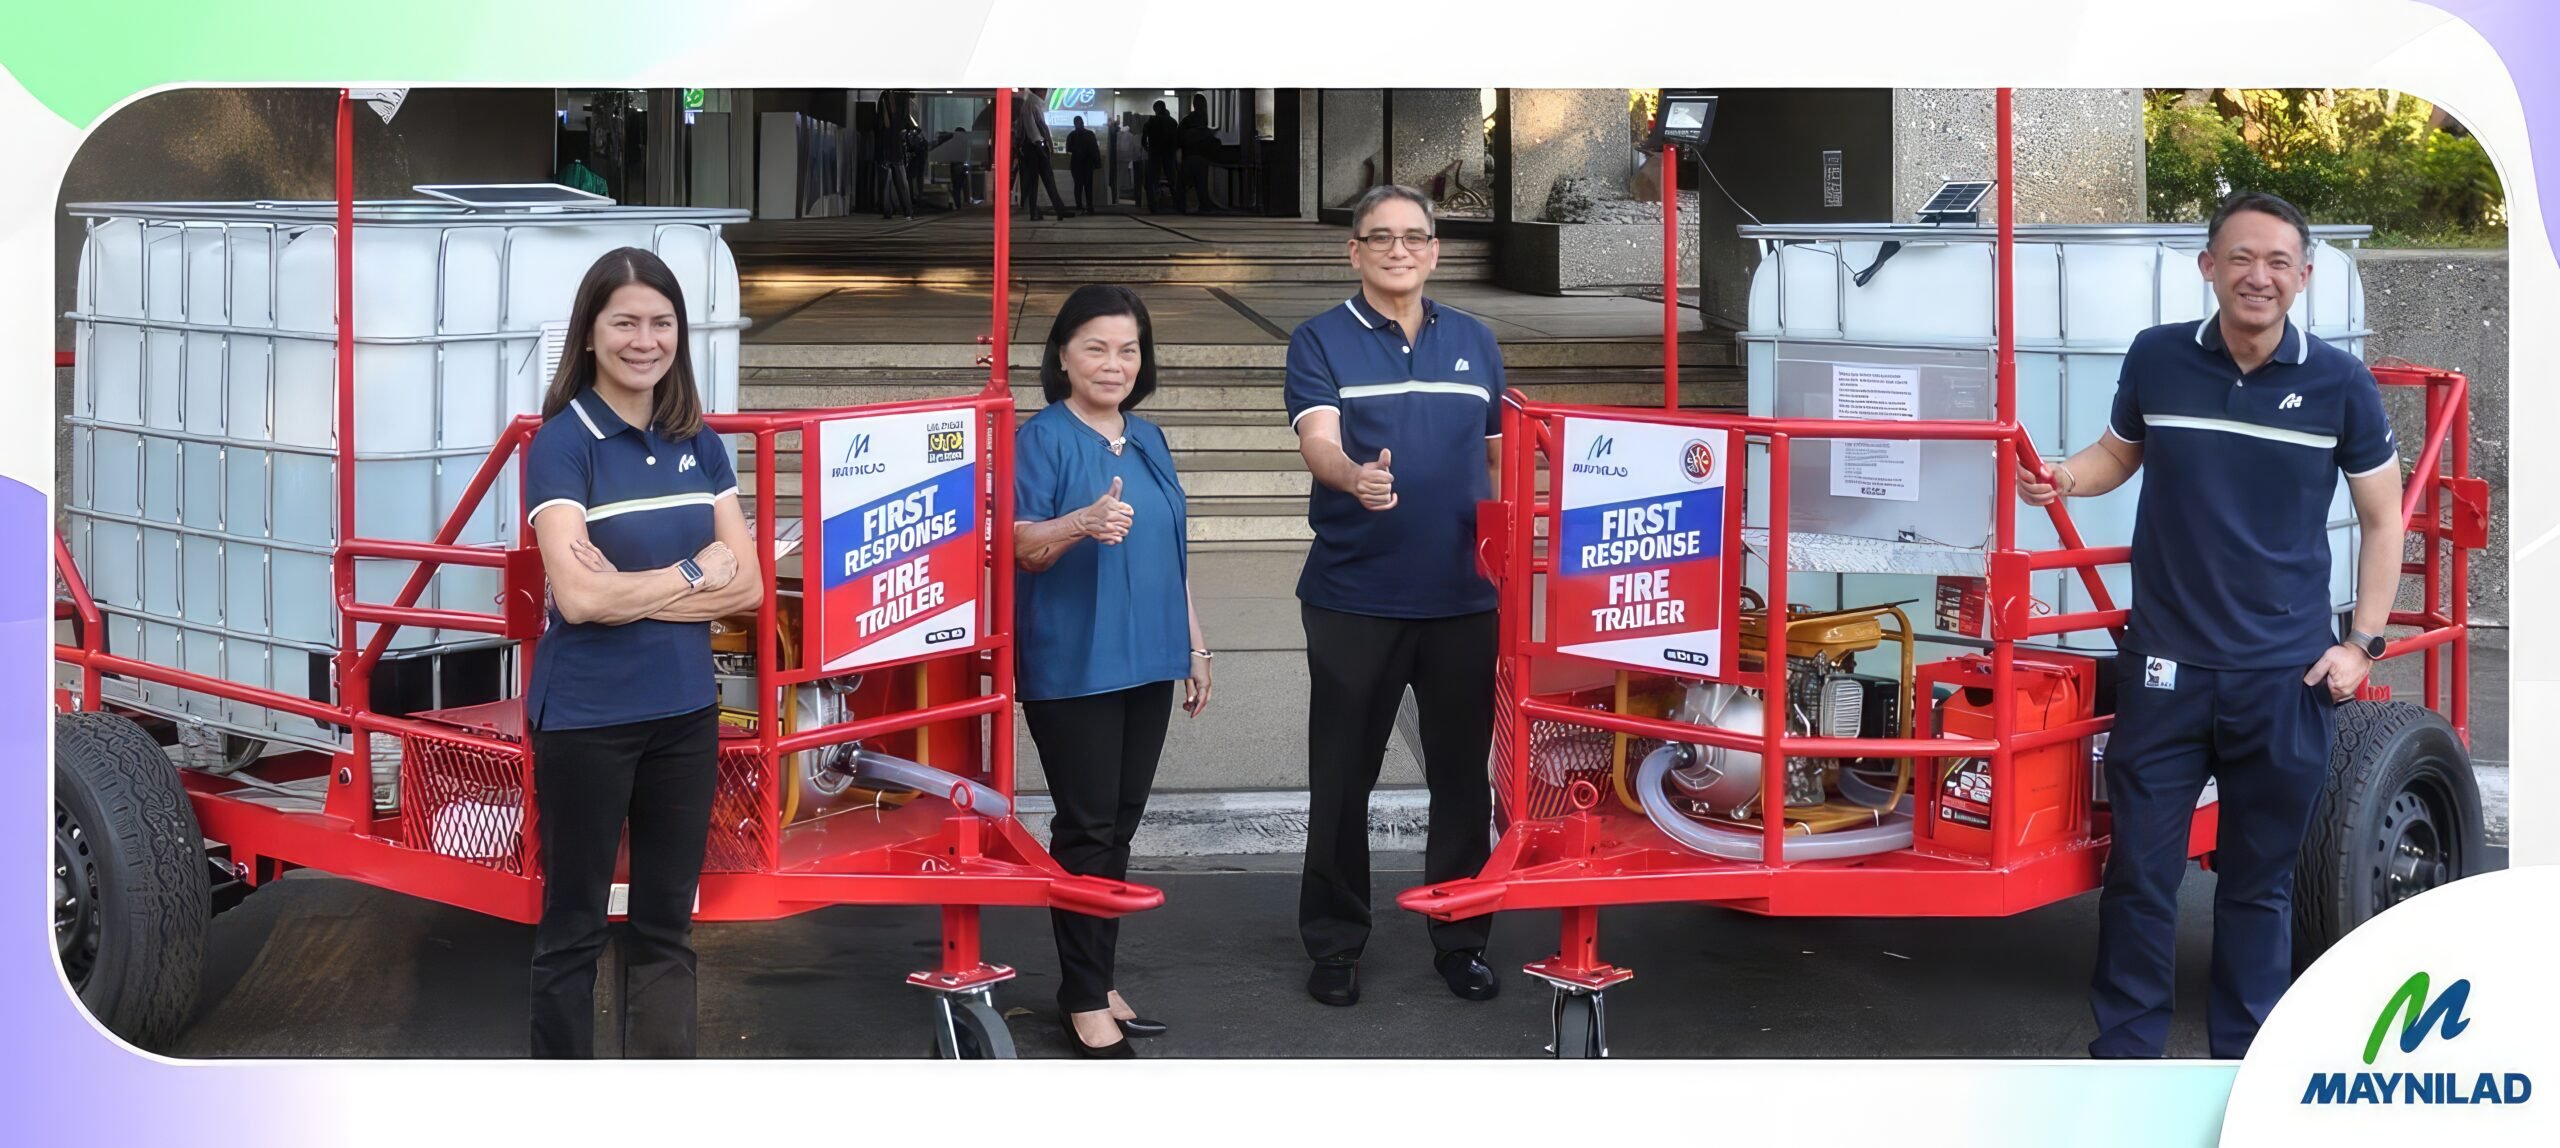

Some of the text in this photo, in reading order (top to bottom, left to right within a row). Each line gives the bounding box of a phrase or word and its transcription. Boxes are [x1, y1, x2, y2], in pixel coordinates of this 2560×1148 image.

[863, 484, 939, 542] FIRST
[1602, 500, 1682, 540] FIRST
[844, 509, 957, 576] RESPONSE
[1581, 530, 1700, 569] RESPONSE
[872, 554, 930, 606] FIRE
[1608, 568, 1670, 605] FIRE
[855, 581, 944, 638] TRAILER
[1591, 599, 1685, 632] TRAILER
